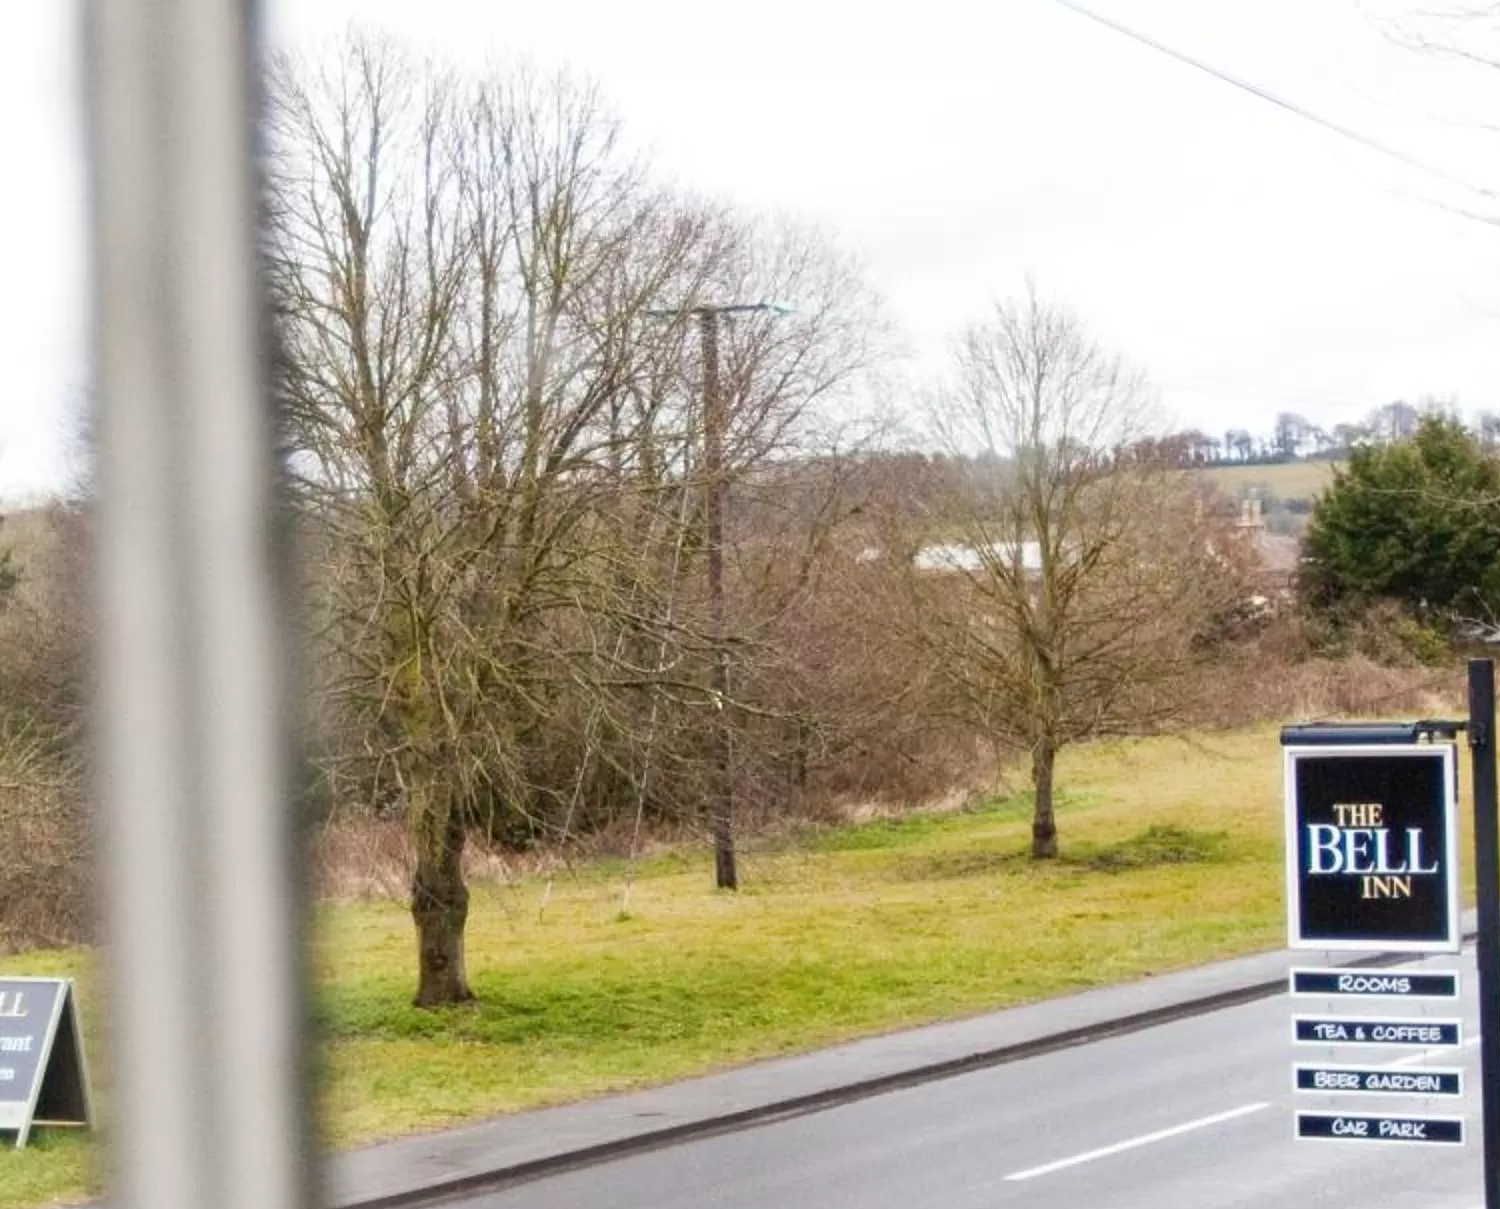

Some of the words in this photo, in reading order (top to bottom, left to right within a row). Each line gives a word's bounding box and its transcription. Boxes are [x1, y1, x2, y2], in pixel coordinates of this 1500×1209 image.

[1332, 803, 1383, 826] THE
[1306, 823, 1439, 875] BELL
[1361, 875, 1412, 899] INN
[1338, 974, 1411, 993] ROOMS
[1314, 1023, 1348, 1039] TEA
[1355, 1026, 1366, 1040] &
[1372, 1025, 1442, 1041] COFFEE
[1314, 1071, 1360, 1089] BEER
[1365, 1073, 1441, 1091] GARDEN
[1331, 1117, 1369, 1136] CAR
[1379, 1119, 1427, 1138] PARK
